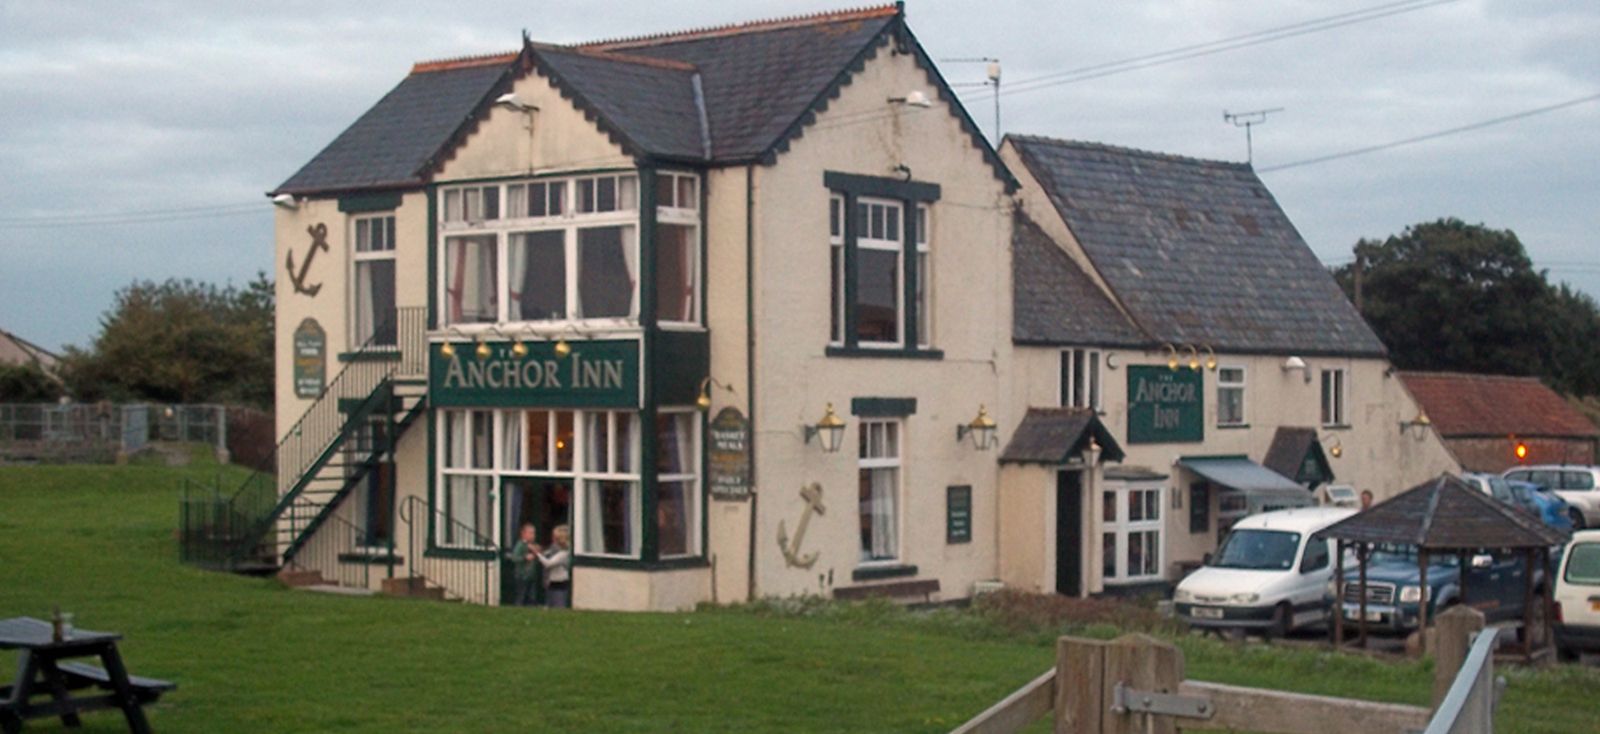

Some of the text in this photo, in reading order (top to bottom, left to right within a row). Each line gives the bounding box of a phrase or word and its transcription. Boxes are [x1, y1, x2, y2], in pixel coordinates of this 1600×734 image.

[443, 352, 624, 389] ANCHOR INN
[1135, 377, 1196, 402] ANCHOR
[1154, 403, 1179, 428] INN
